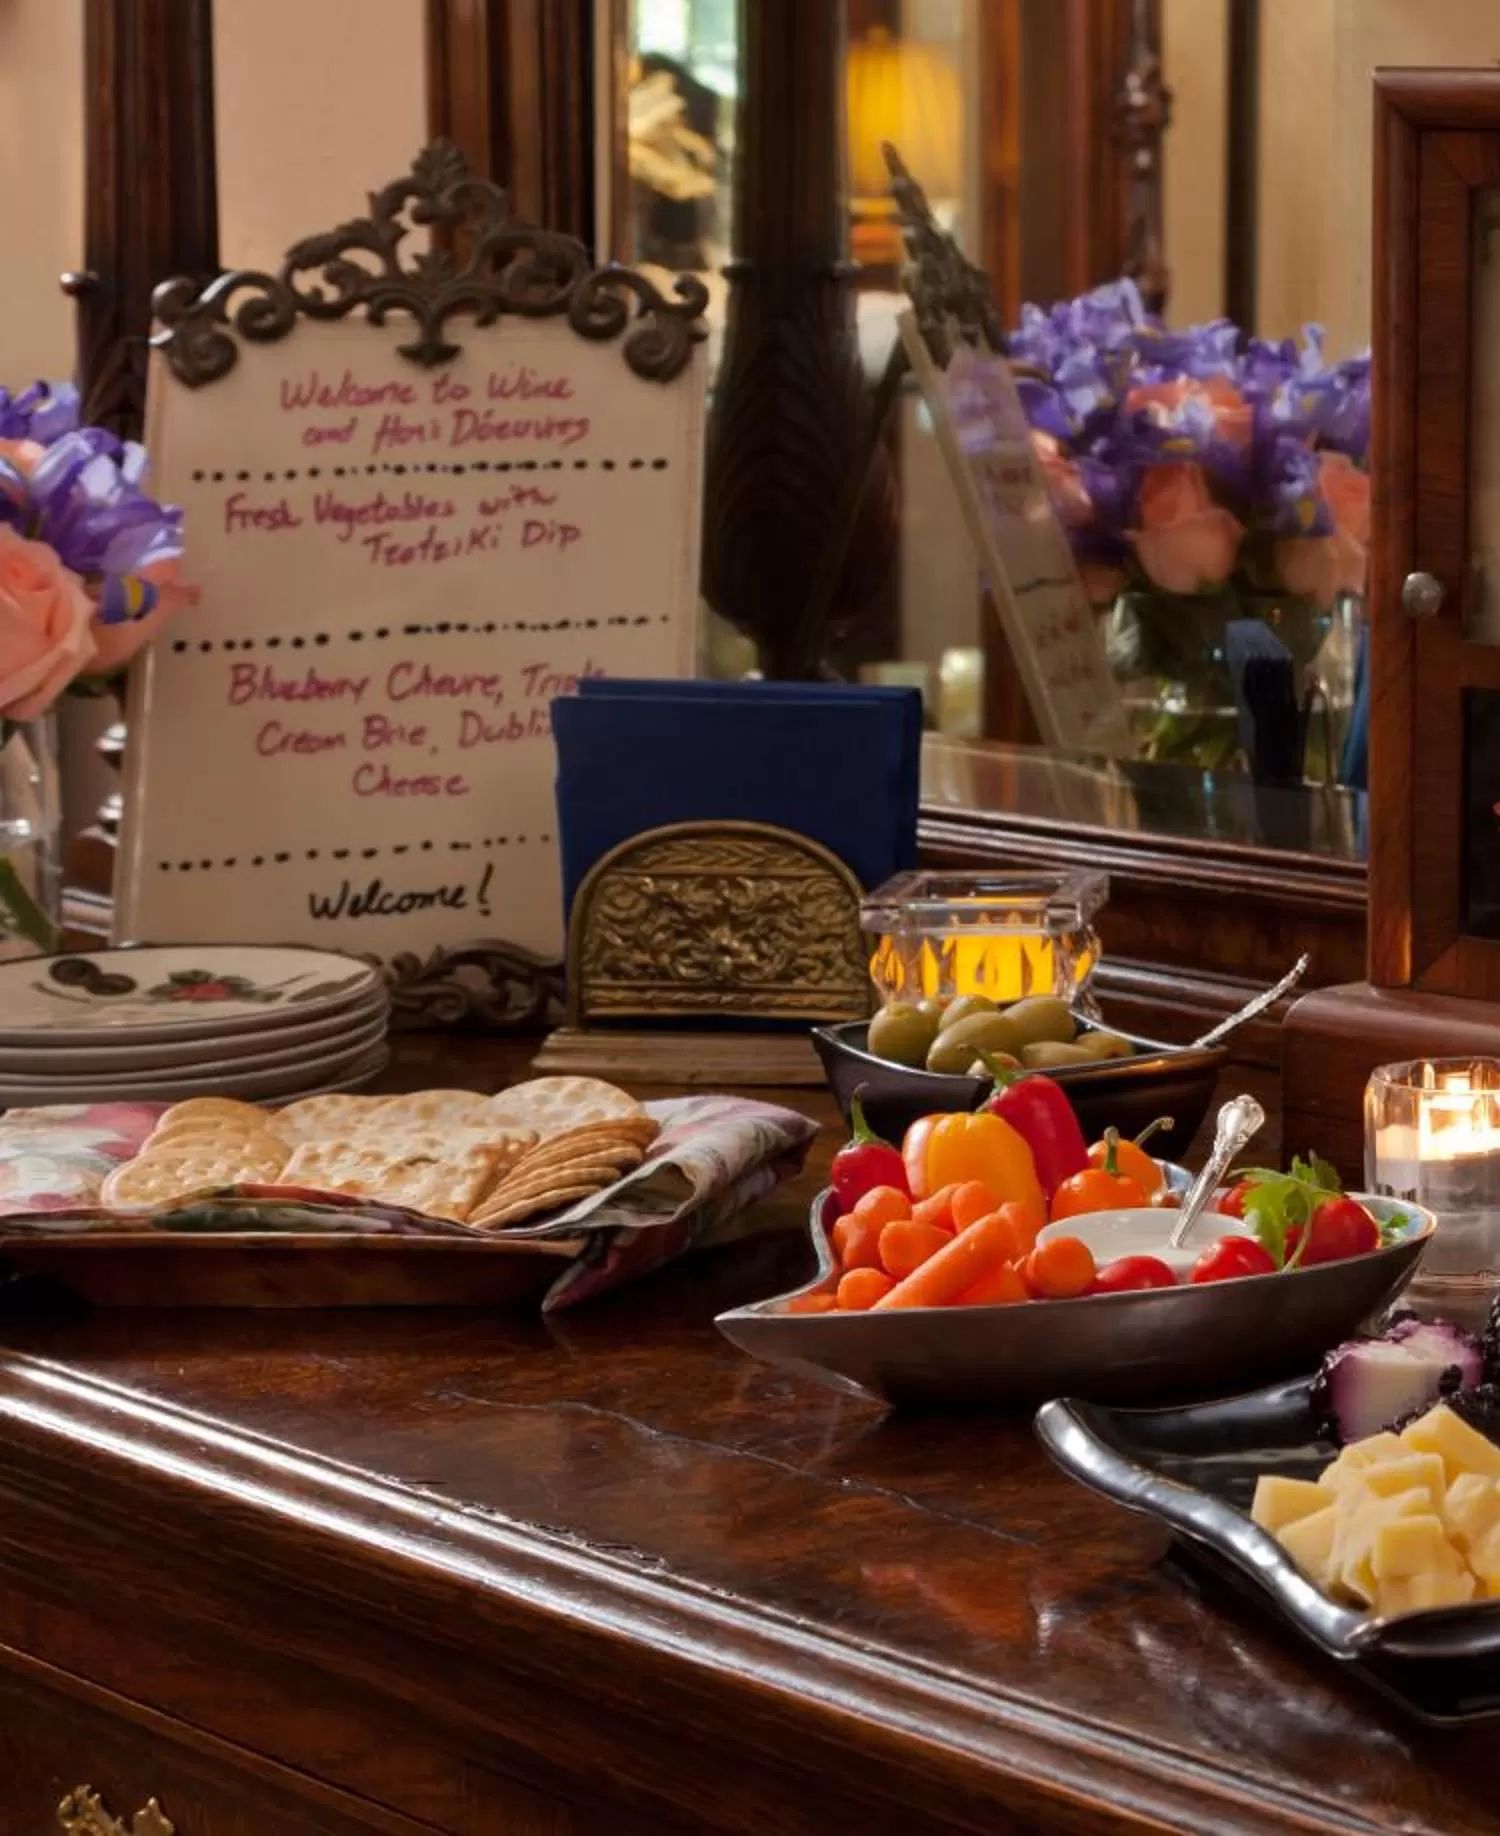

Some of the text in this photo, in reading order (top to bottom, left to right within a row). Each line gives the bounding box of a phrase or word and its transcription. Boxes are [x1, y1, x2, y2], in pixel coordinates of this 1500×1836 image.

[281, 366, 575, 410] Welcome to Wine
[302, 416, 358, 447] and
[225, 492, 303, 534] Fresh
[314, 490, 456, 543] Vegetables
[520, 519, 582, 552] Dip
[256, 720, 346, 757] Cream
[458, 708, 551, 749] Dubli
[353, 762, 470, 796] Cheese
[309, 861, 494, 919] Welcome!
